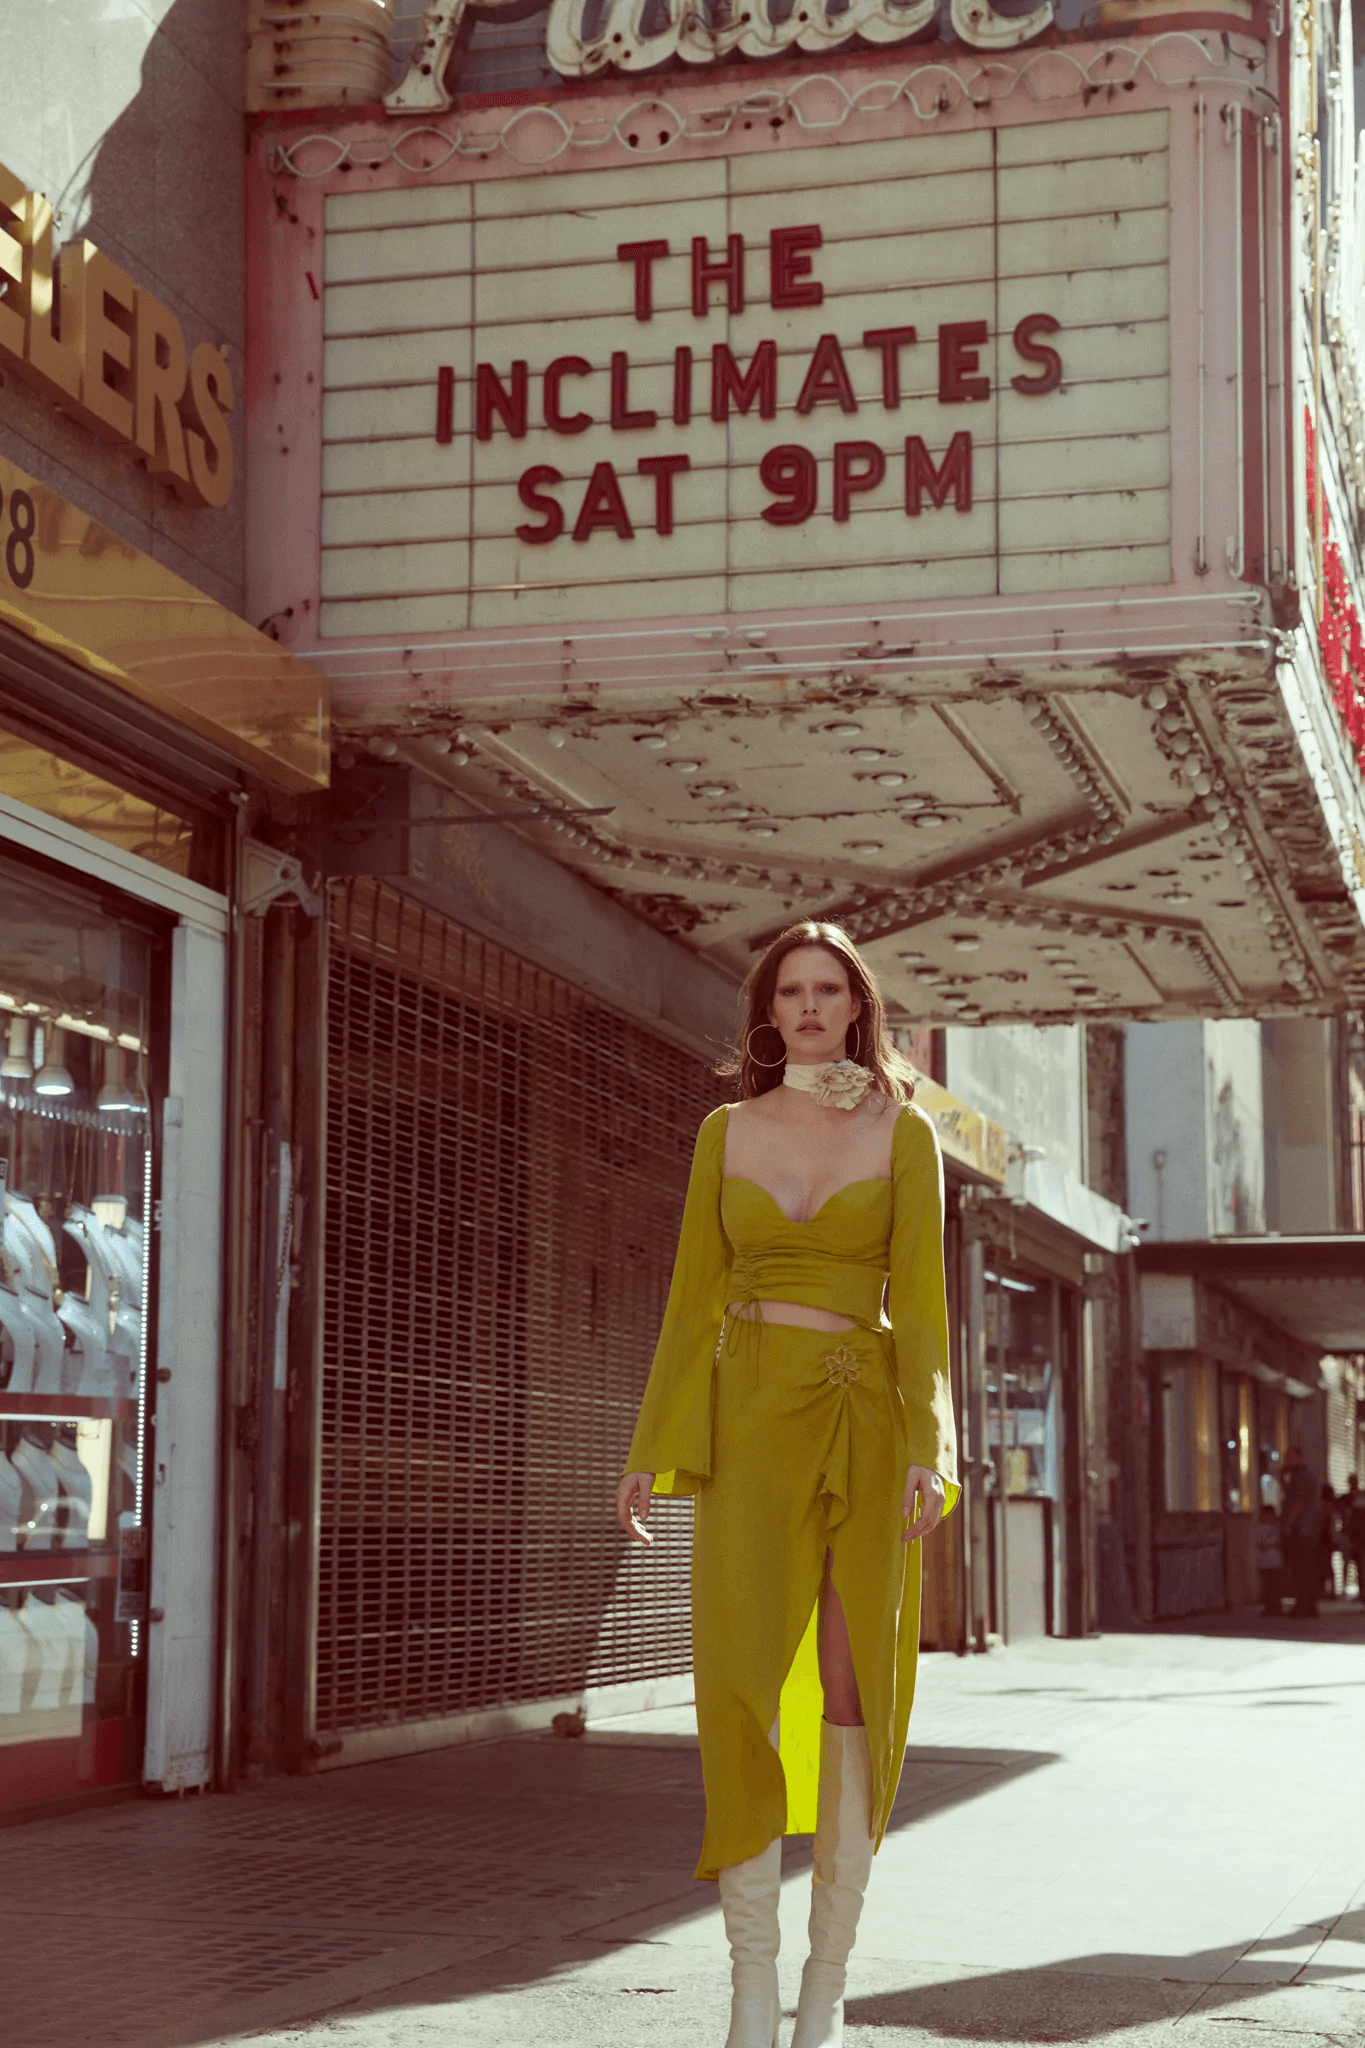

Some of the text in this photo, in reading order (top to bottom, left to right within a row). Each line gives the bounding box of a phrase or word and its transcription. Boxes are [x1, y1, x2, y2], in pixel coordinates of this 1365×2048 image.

[617, 224, 824, 323] THE
[435, 313, 1063, 446] INCLIMATES
[0, 481, 36, 590] 8
[516, 431, 974, 545] SAT 9PM
